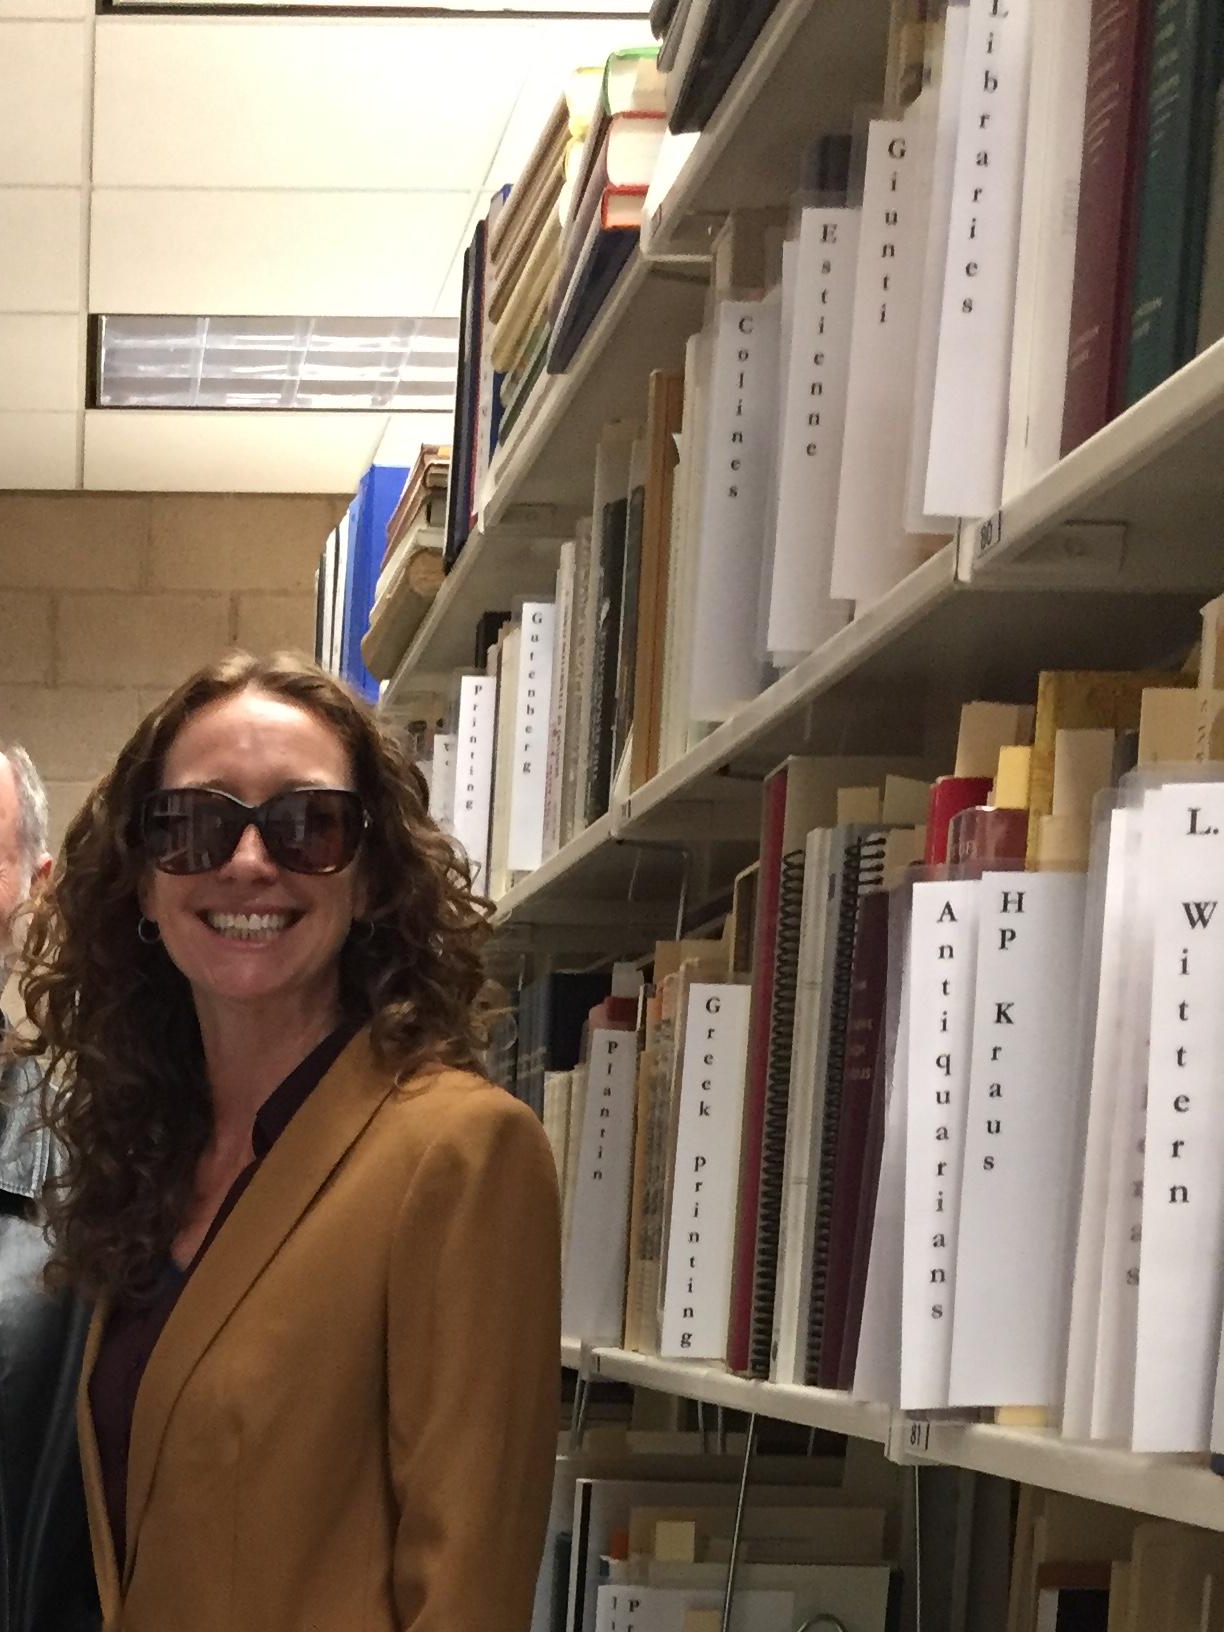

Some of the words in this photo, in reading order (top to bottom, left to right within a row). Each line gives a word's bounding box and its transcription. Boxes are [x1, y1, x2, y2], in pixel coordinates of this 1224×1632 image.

[879, 137, 907, 326] Giunti
[962, 0, 1010, 316] Libraries
[728, 317, 754, 499] Colines
[806, 224, 837, 458] Estienne
[465, 684, 483, 810] Printing
[522, 612, 544, 775] Gutenberg
[1185, 807, 1220, 837] L.
[999, 891, 1027, 952] HP
[591, 1039, 619, 1181] Plantin
[698, 996, 721, 1118] Greek
[929, 900, 959, 1322] Antiquarians
[982, 1002, 1015, 1174] Kraus
[1168, 901, 1220, 1206] Wittern
[680, 1154, 707, 1349] printing
